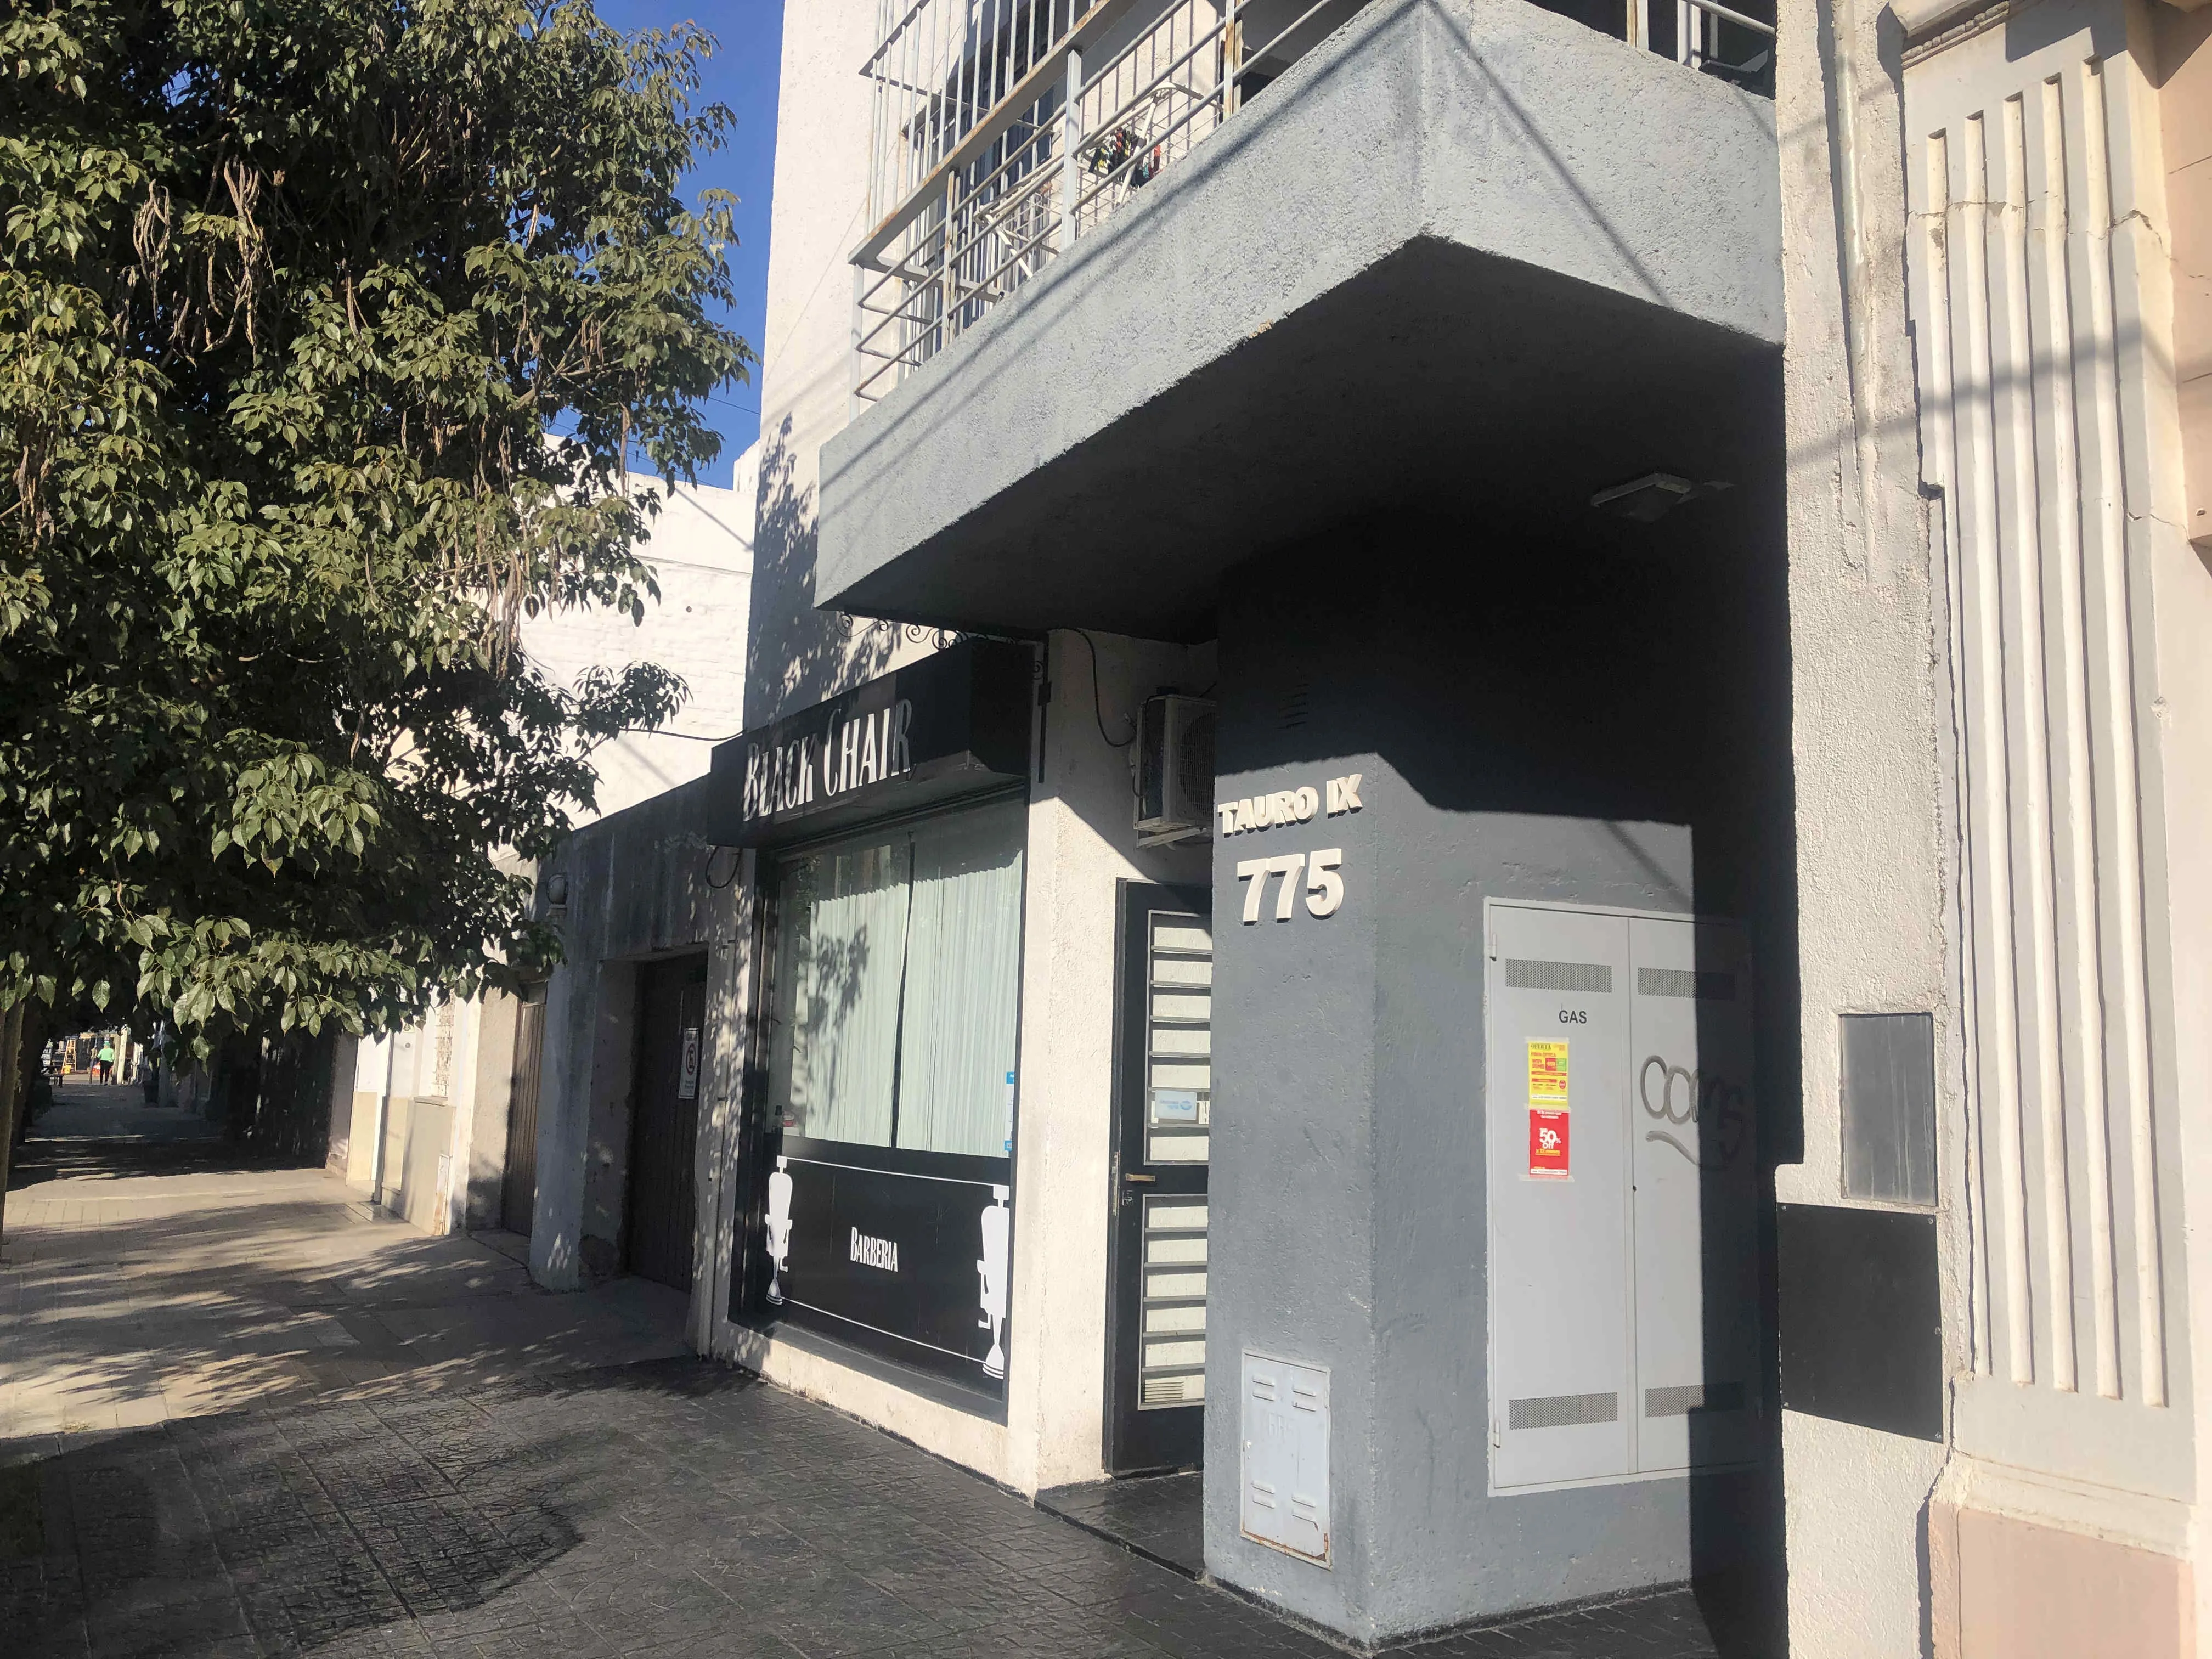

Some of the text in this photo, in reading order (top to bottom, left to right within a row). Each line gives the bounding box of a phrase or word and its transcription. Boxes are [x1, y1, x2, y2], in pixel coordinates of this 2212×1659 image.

[743, 698, 913, 822] BLACK CHAIR
[1217, 774, 1363, 836] TAURO IX
[1237, 848, 1344, 924] 775
[1558, 1010, 1587, 1024] GAS
[850, 1226, 898, 1272] BARBERIA
